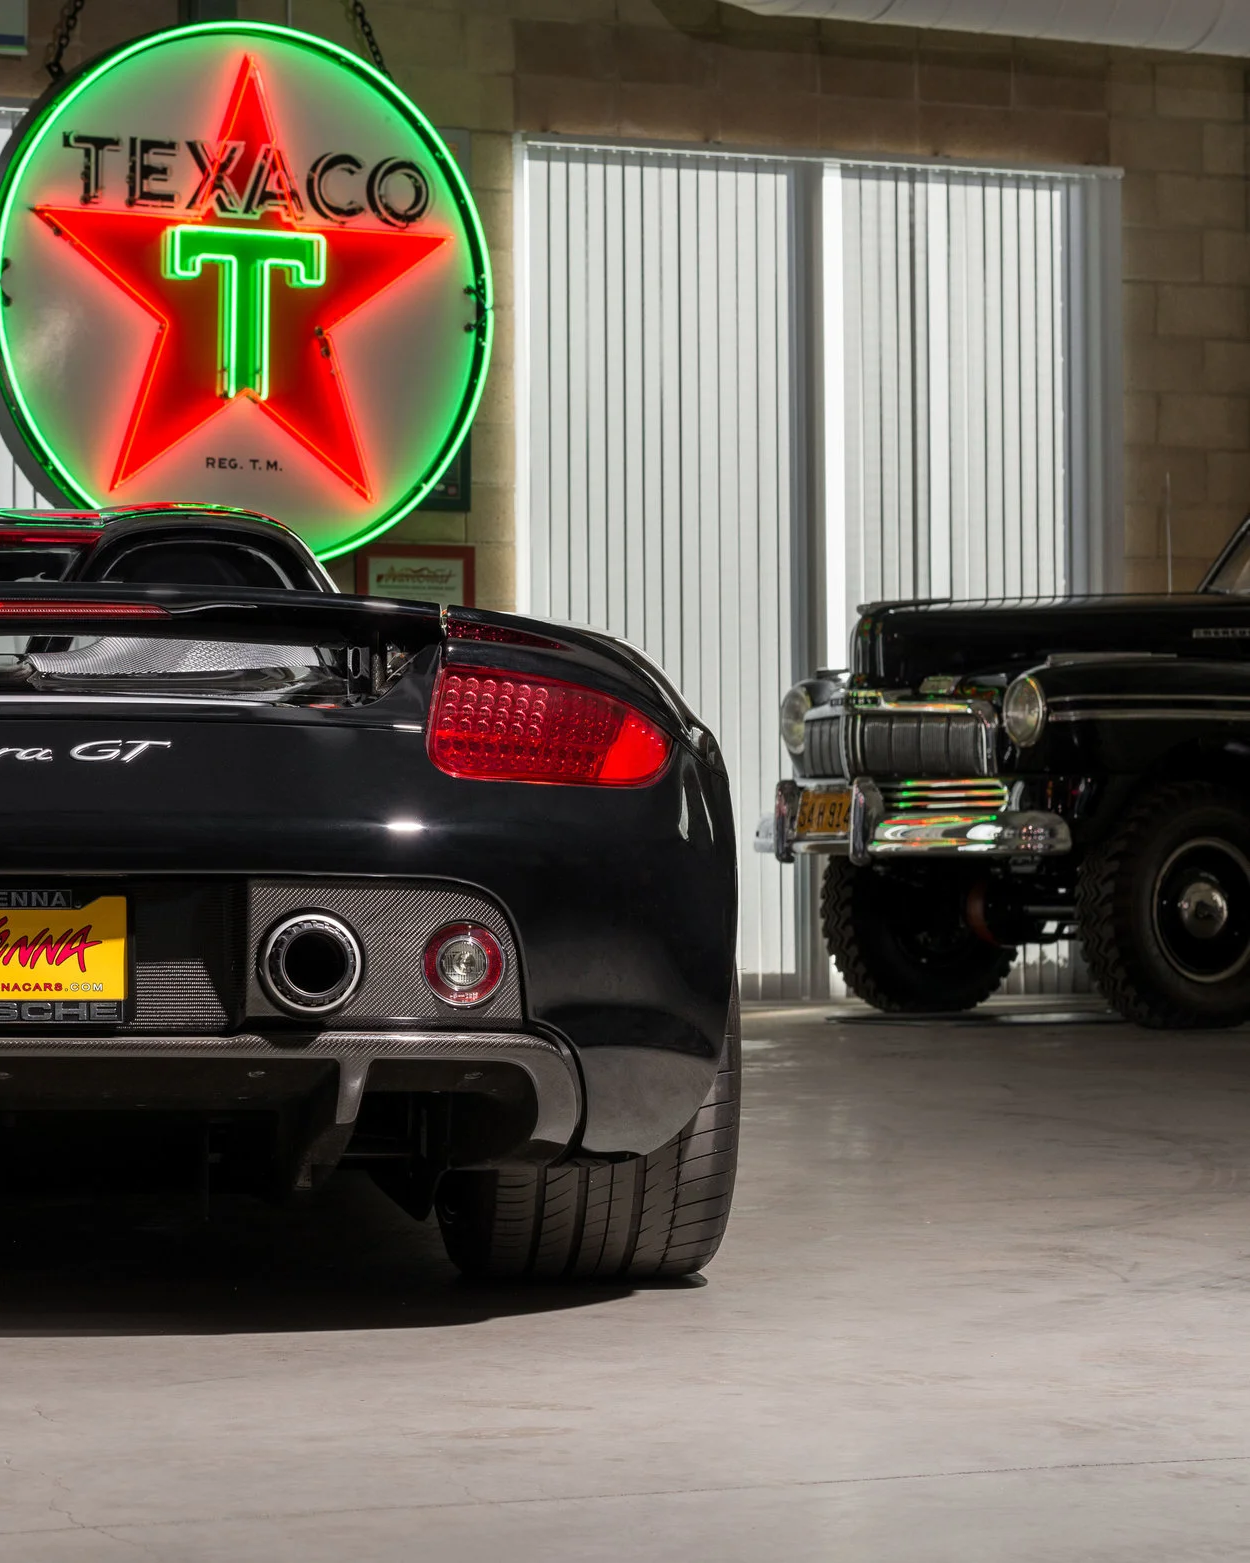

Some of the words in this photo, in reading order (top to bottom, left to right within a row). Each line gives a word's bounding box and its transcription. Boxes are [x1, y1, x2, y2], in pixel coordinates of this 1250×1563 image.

[62, 129, 433, 229] TEXACO
[161, 224, 326, 401] T
[205, 456, 243, 470] REG.
[69, 738, 171, 764] GT
